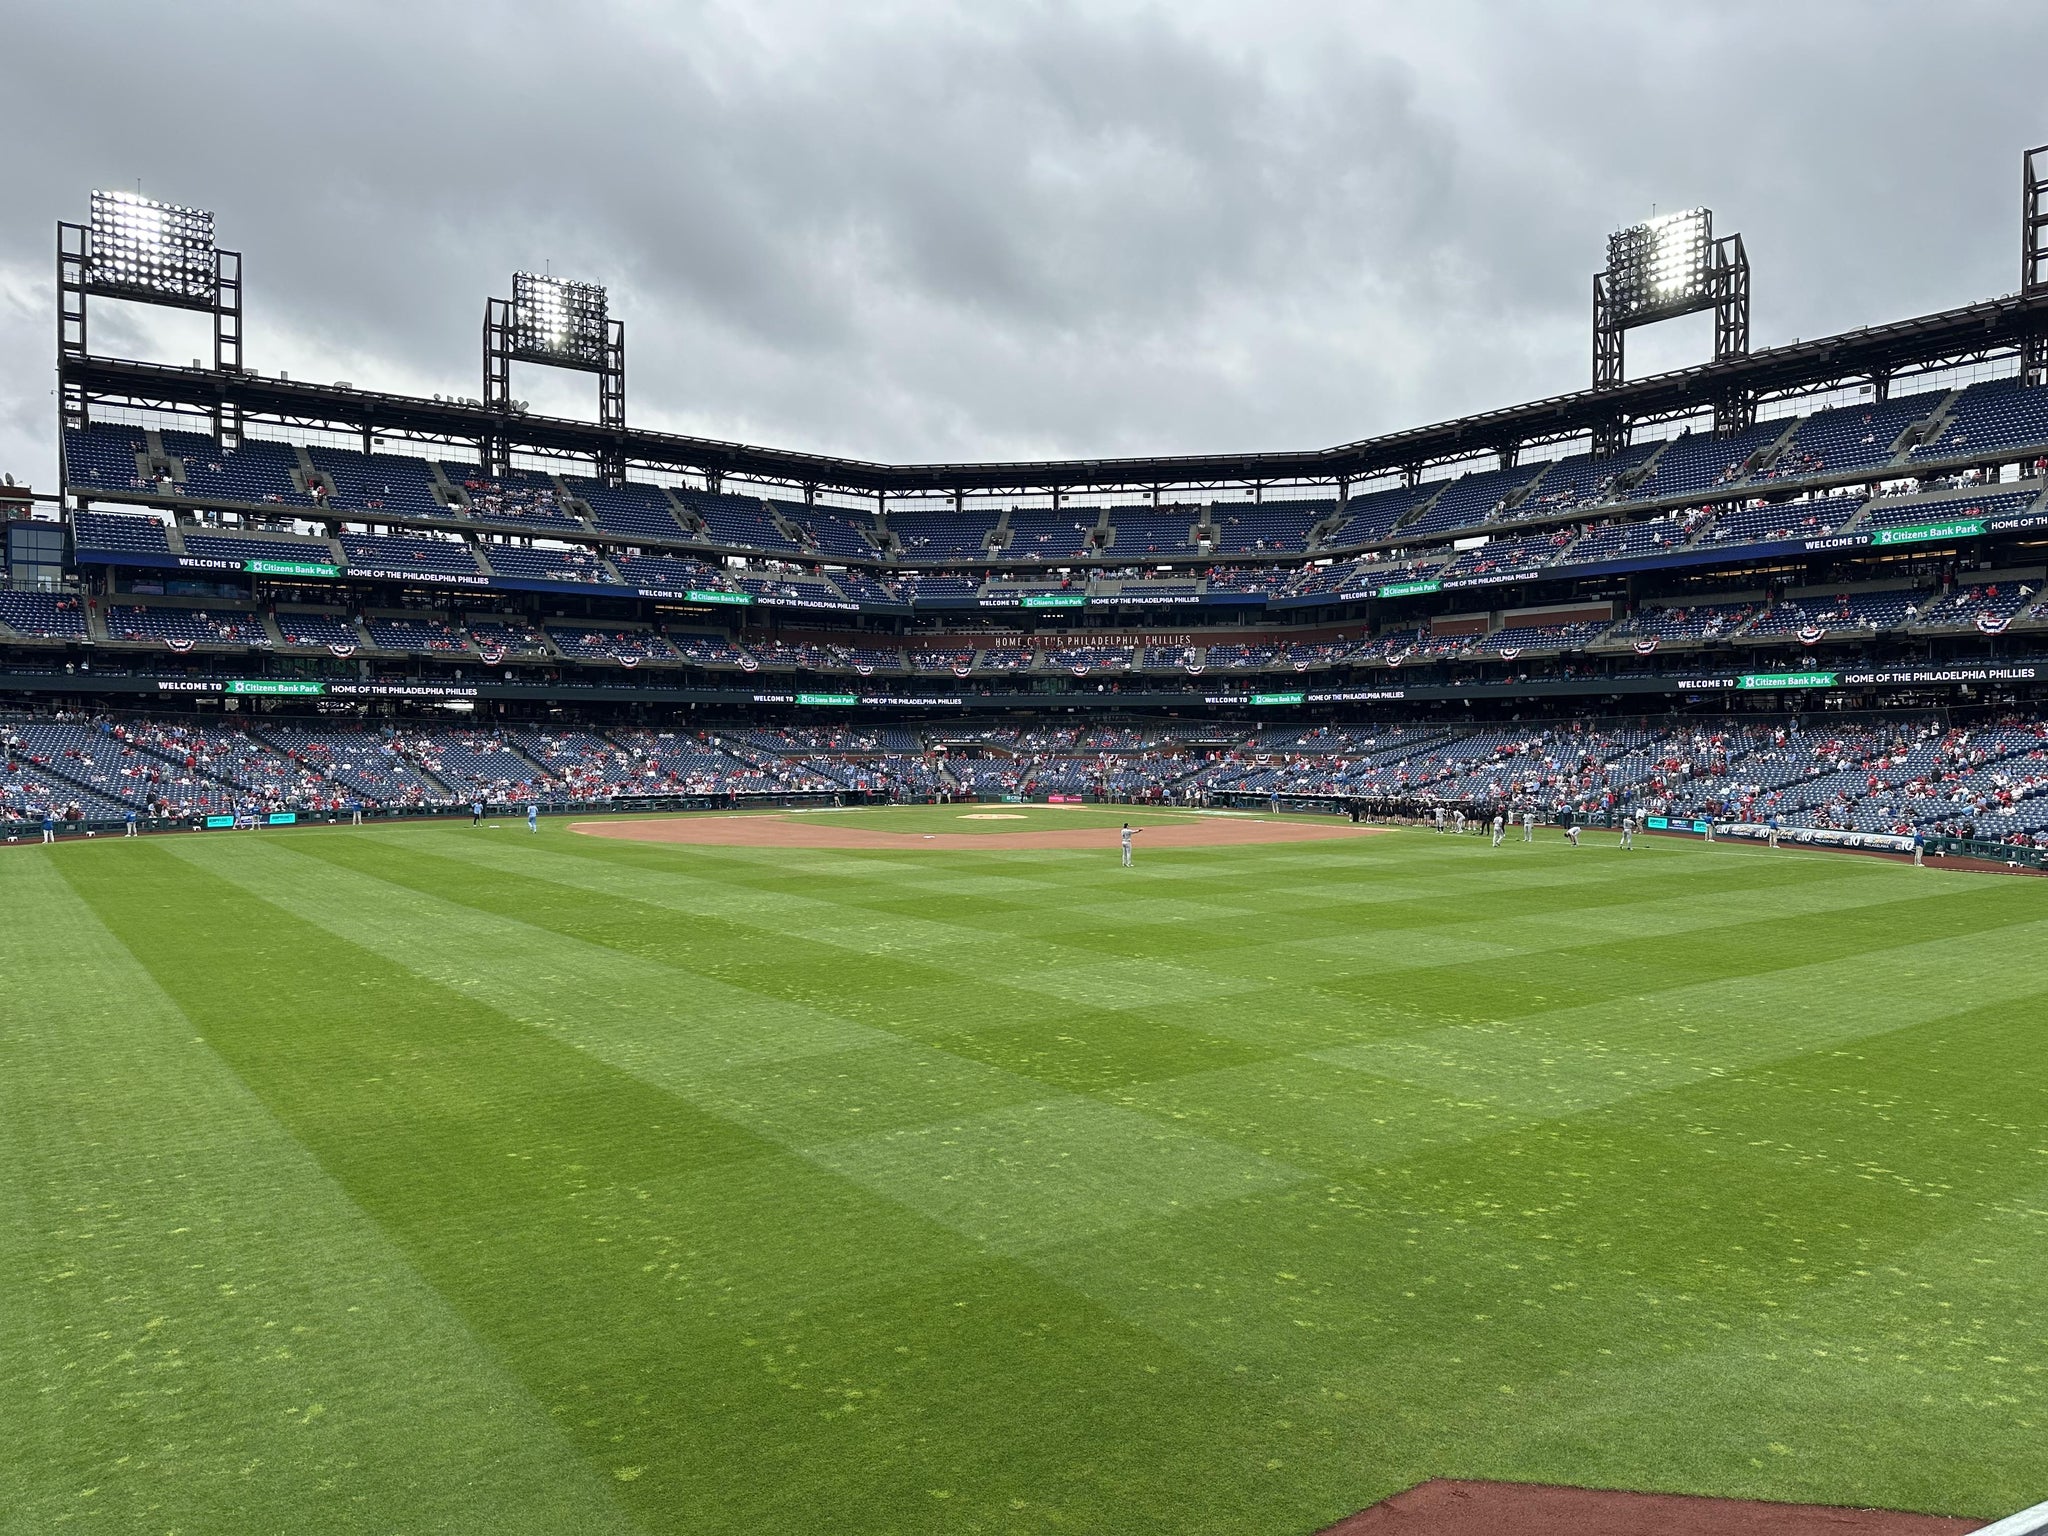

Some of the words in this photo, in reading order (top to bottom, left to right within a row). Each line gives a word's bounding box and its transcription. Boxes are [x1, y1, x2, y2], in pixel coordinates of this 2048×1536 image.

[1805, 538, 1852, 549] WELCOME
[1856, 536, 1867, 544] TO
[1893, 531, 1928, 541] Citizens
[1930, 528, 1953, 537] Bank
[1956, 524, 1977, 534] Park
[1991, 520, 2018, 530] HOME
[2035, 517, 2048, 525] TH
[179, 558, 226, 568] WELCOME
[263, 563, 293, 572] Citizens
[296, 566, 314, 574] Bank
[317, 567, 334, 575] Park
[348, 569, 371, 577] HOME
[403, 572, 456, 582] PHILADELPHIA
[458, 576, 489, 584] PHILLIES
[639, 589, 672, 597] WELCOME
[1341, 591, 1367, 600] WELCOME
[996, 638, 1021, 646] HOME
[1068, 636, 1139, 645] PHILADELPHIA
[1678, 680, 1720, 688] WELCOME
[1755, 678, 1786, 686] Citizens
[1788, 677, 1808, 685] Bank
[1810, 676, 1830, 684] Park
[1845, 674, 1874, 683] HOME
[1876, 673, 1890, 682] OF
[1892, 673, 1911, 682] THE
[1913, 670, 1985, 681] PHILADELPHIA
[1989, 668, 2034, 678] PHILLIES
[158, 682, 207, 690] WELCOME
[245, 683, 276, 691] Citizens
[278, 684, 298, 692] Bank
[371, 686, 386, 694] THE
[389, 687, 443, 695] PHILADELPHIA
[446, 688, 477, 696] PHILLIES
